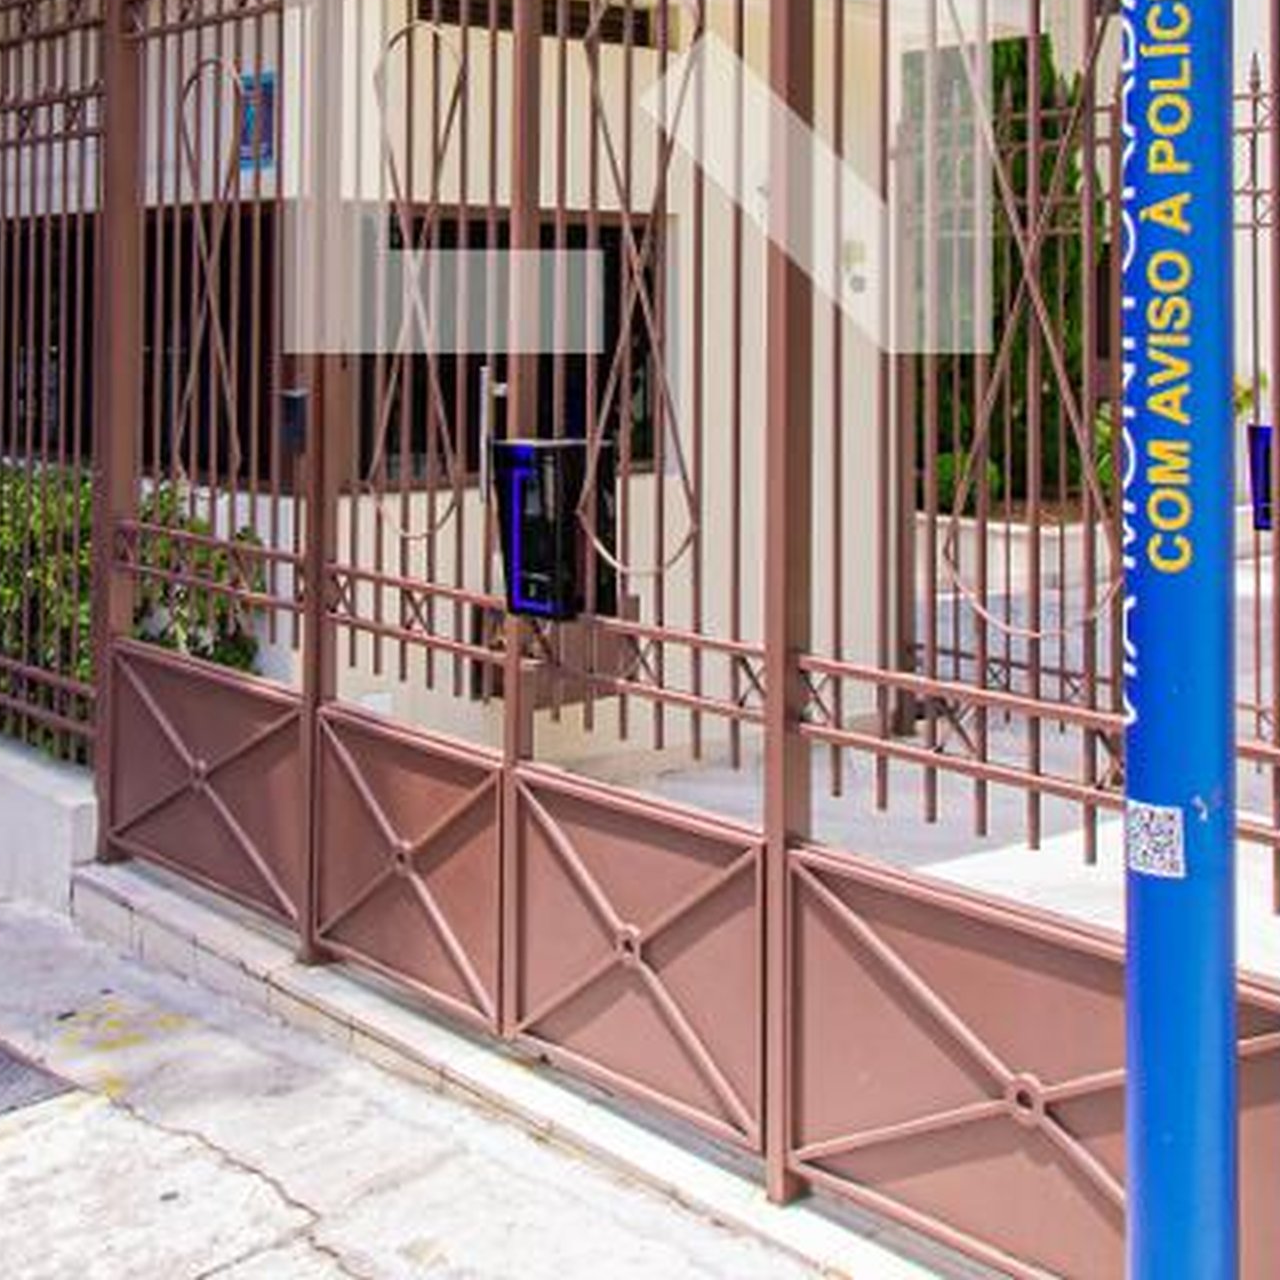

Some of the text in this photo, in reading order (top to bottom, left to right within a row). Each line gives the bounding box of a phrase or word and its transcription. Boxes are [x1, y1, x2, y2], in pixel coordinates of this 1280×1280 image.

[1140, 193, 1192, 234] À
[1147, 250, 1192, 424] AVISO
[1147, 440, 1192, 573] COM
